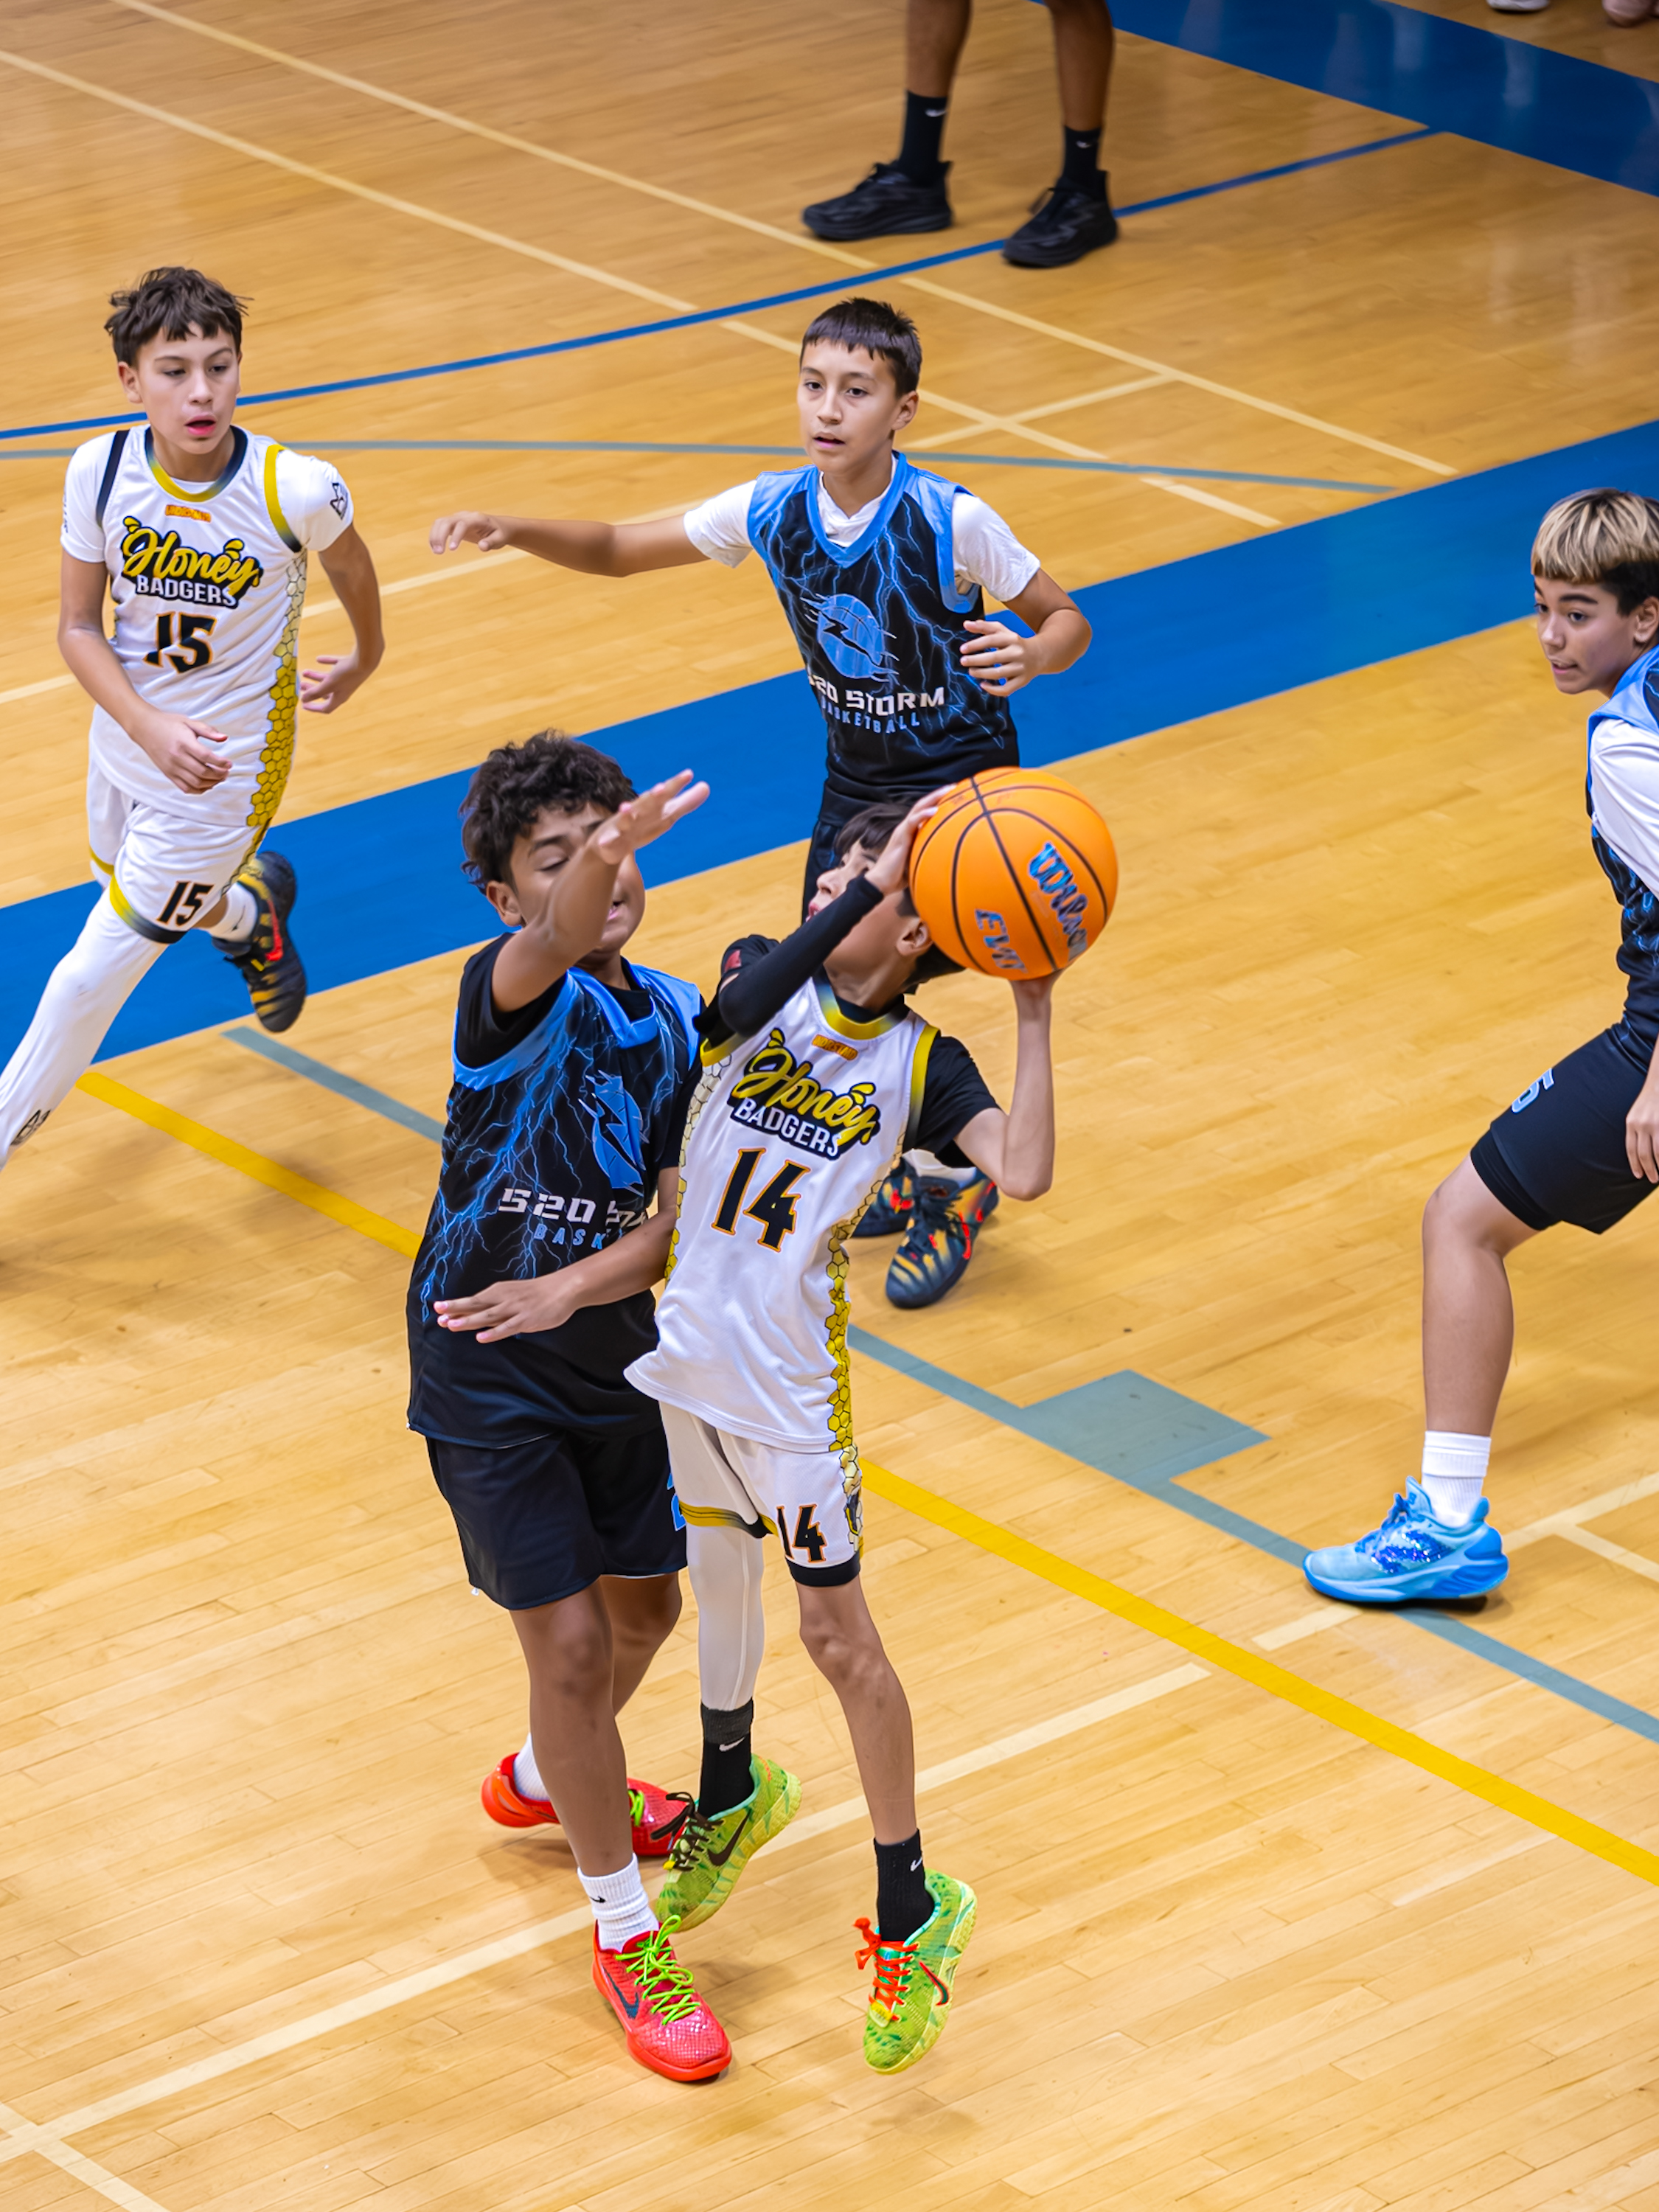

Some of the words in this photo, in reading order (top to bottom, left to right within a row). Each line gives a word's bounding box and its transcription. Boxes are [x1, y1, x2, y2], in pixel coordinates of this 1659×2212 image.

[122, 522, 261, 597] Honey
[136, 574, 238, 608] BADGERS
[143, 611, 218, 675] 15
[845, 686, 946, 717] STORM
[156, 880, 215, 927] 15
[731, 1040, 879, 1146] Honey
[734, 1096, 842, 1158] BADGERS
[498, 1188, 597, 1224] 520
[712, 1147, 811, 1253] 14
[776, 1503, 827, 1564] 14
